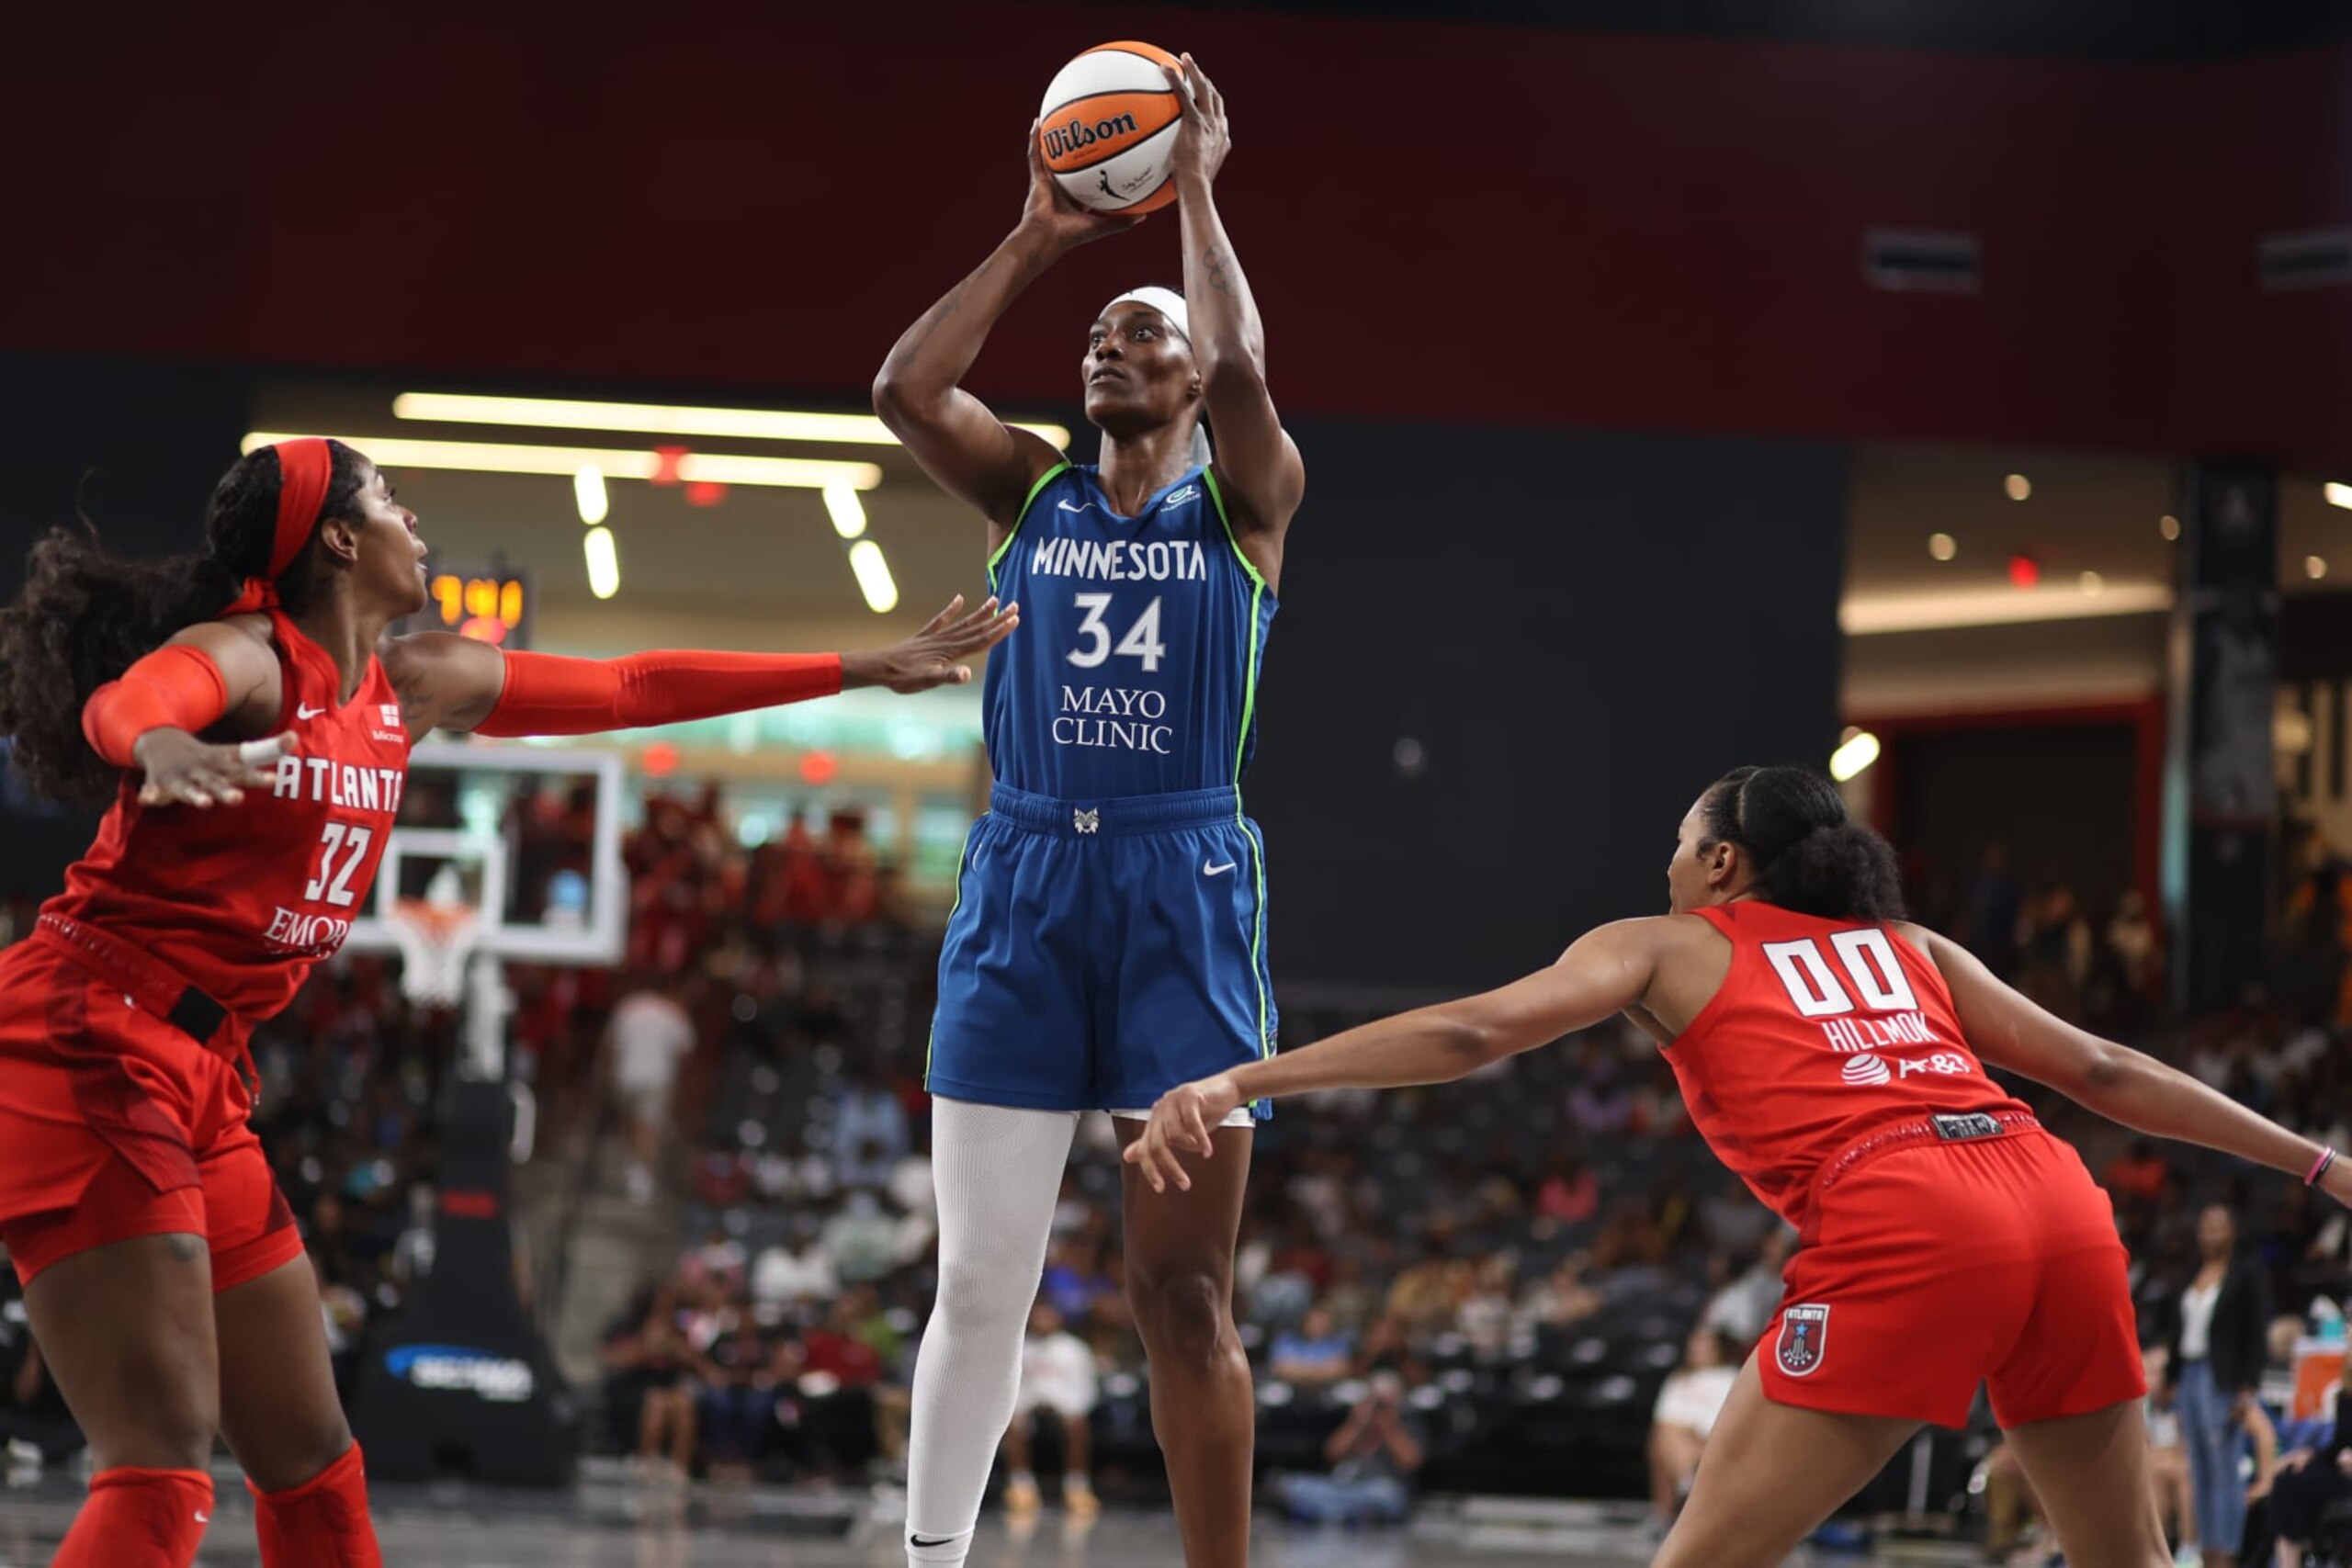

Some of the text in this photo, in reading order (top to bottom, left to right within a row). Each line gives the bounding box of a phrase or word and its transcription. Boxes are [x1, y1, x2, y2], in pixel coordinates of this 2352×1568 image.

[1045, 113, 1136, 160] Wilson
[1032, 536, 1206, 581] MINNESOTA
[1067, 592, 1166, 672] 34
[1060, 684, 1166, 718] MAYO
[1052, 717, 1172, 754] CLINIC
[304, 823, 371, 907] 32
[263, 906, 352, 948] EMOR
[1761, 928, 1919, 1018] 00
